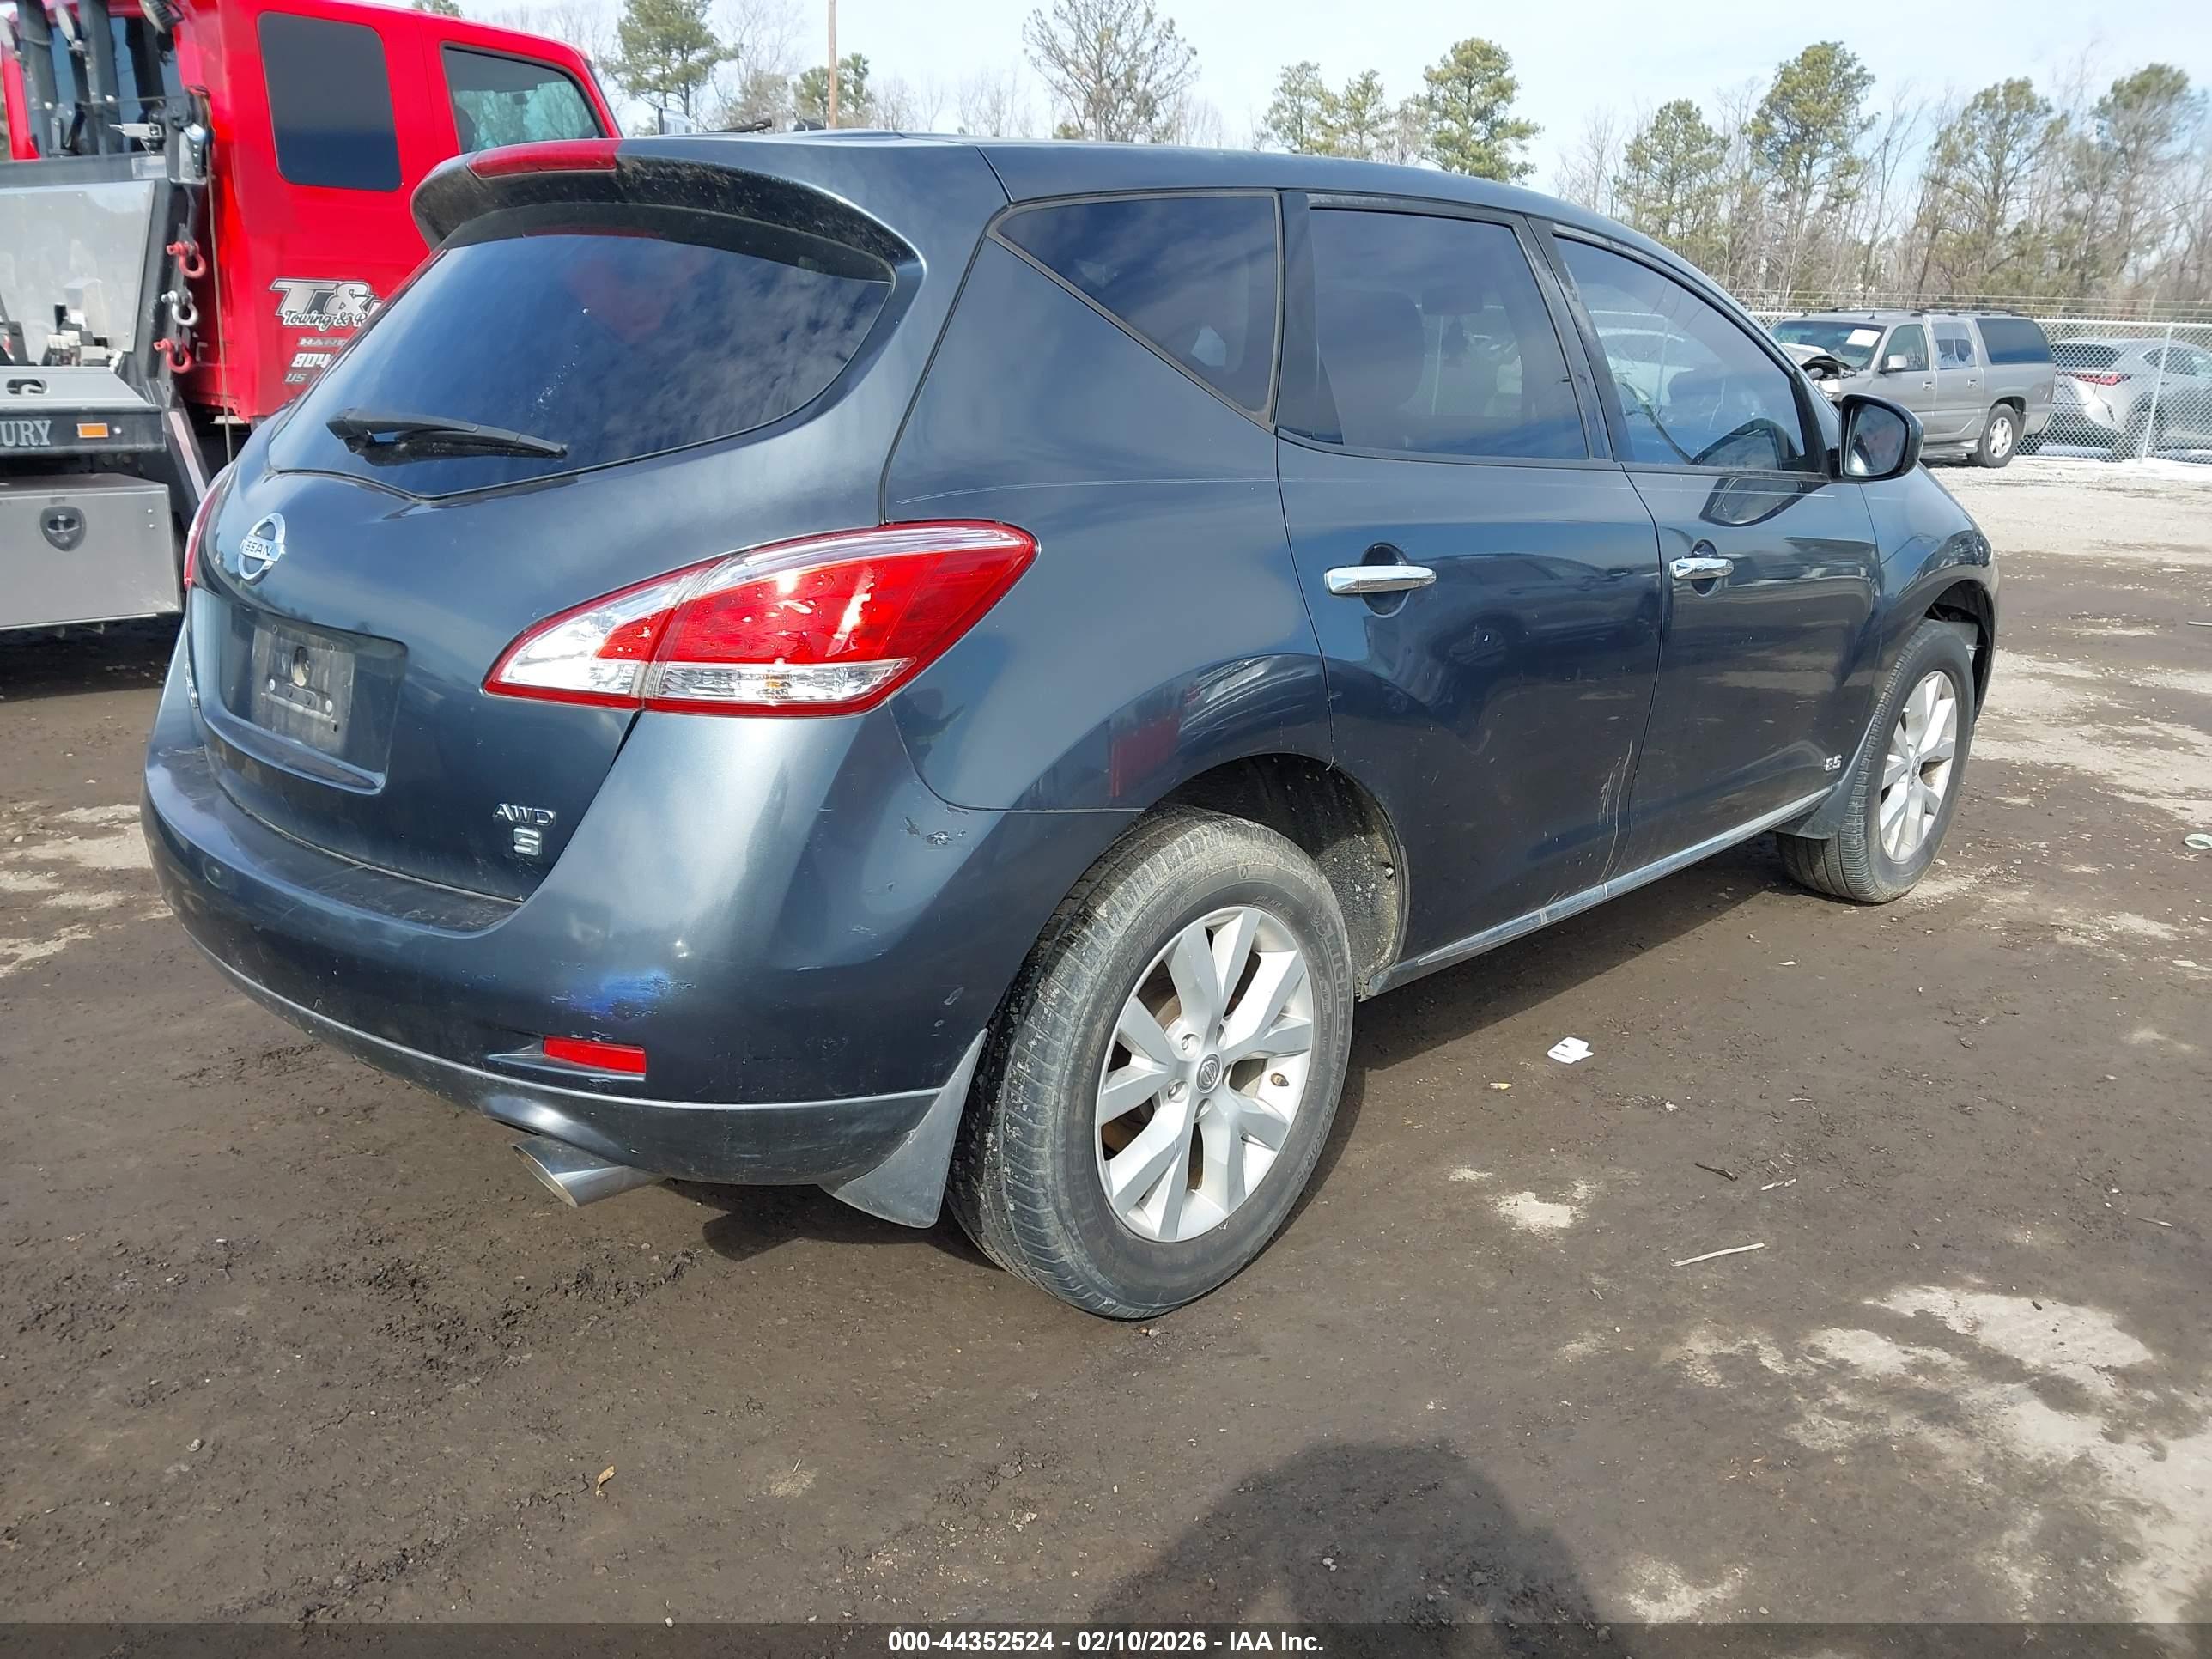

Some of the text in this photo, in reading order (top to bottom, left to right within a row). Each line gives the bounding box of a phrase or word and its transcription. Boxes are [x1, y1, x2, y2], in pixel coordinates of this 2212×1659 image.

[269, 278, 385, 316] T&
[283, 310, 332, 331] Towing
[333, 313, 352, 327] &
[290, 352, 333, 368] 804
[0, 419, 52, 447] URY
[240, 540, 273, 556] SSAN
[492, 803, 556, 826] AWD
[514, 826, 542, 856] S
